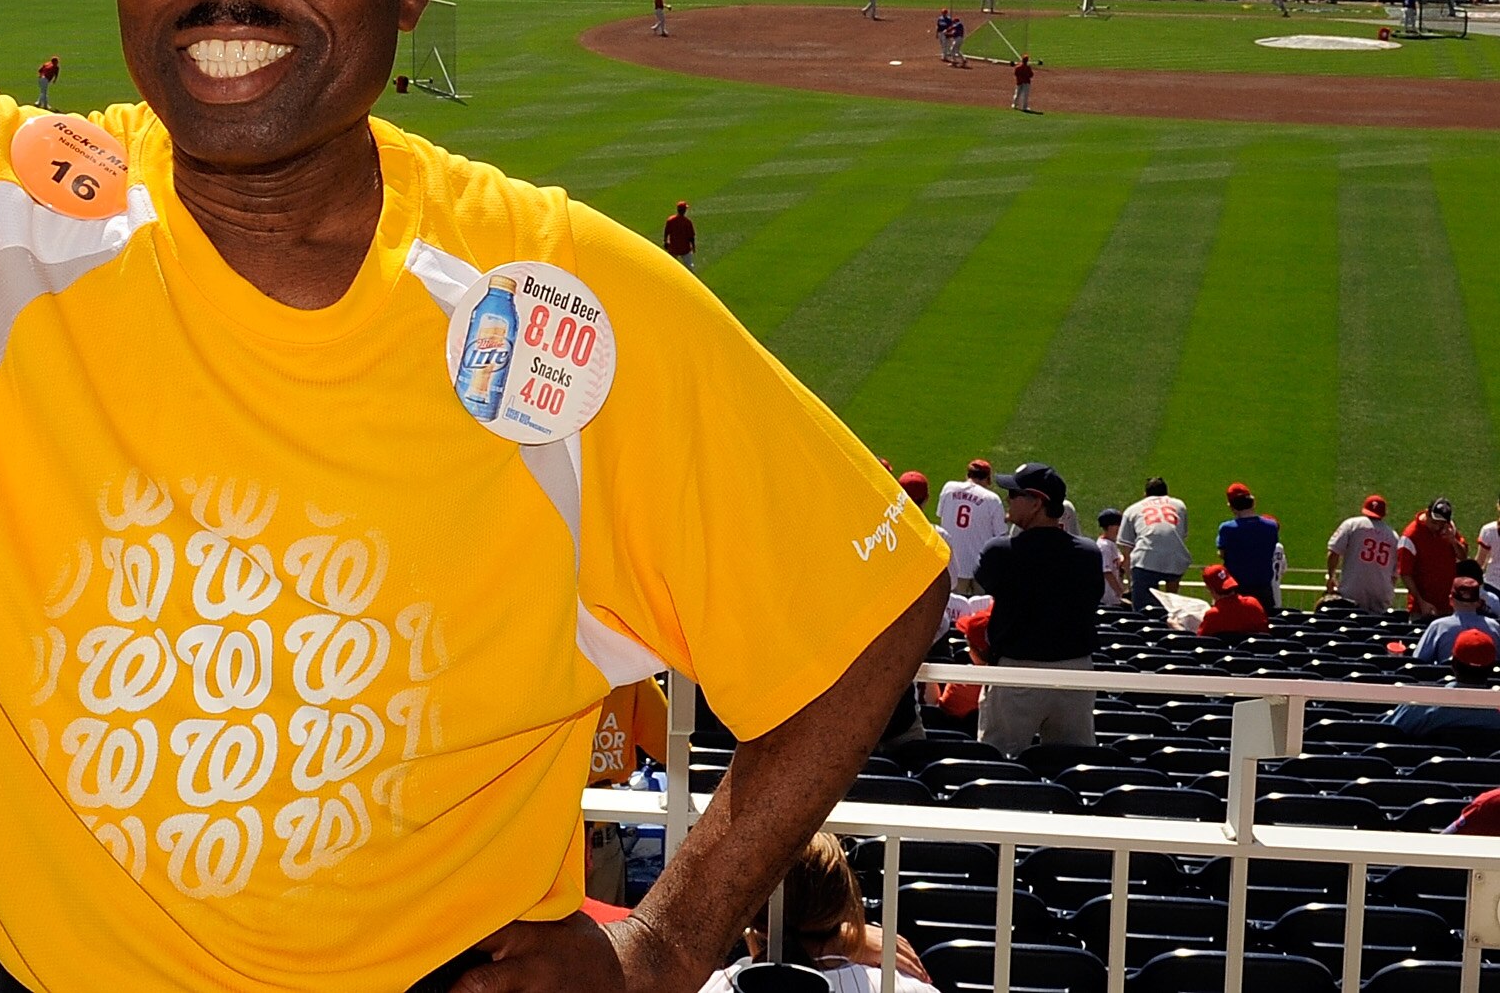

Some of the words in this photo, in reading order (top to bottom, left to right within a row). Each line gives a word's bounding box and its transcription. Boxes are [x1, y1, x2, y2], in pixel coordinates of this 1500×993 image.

[53, 122, 106, 156] Rocket
[58, 136, 97, 164] Nationals
[51, 159, 101, 201] 16
[523, 276, 571, 311] Bottled
[570, 296, 601, 324] Beer
[524, 304, 597, 367] 8.00
[530, 356, 572, 388] Snacks
[520, 377, 566, 416] 4.00
[956, 504, 972, 529] 6
[1360, 538, 1393, 567] 35
